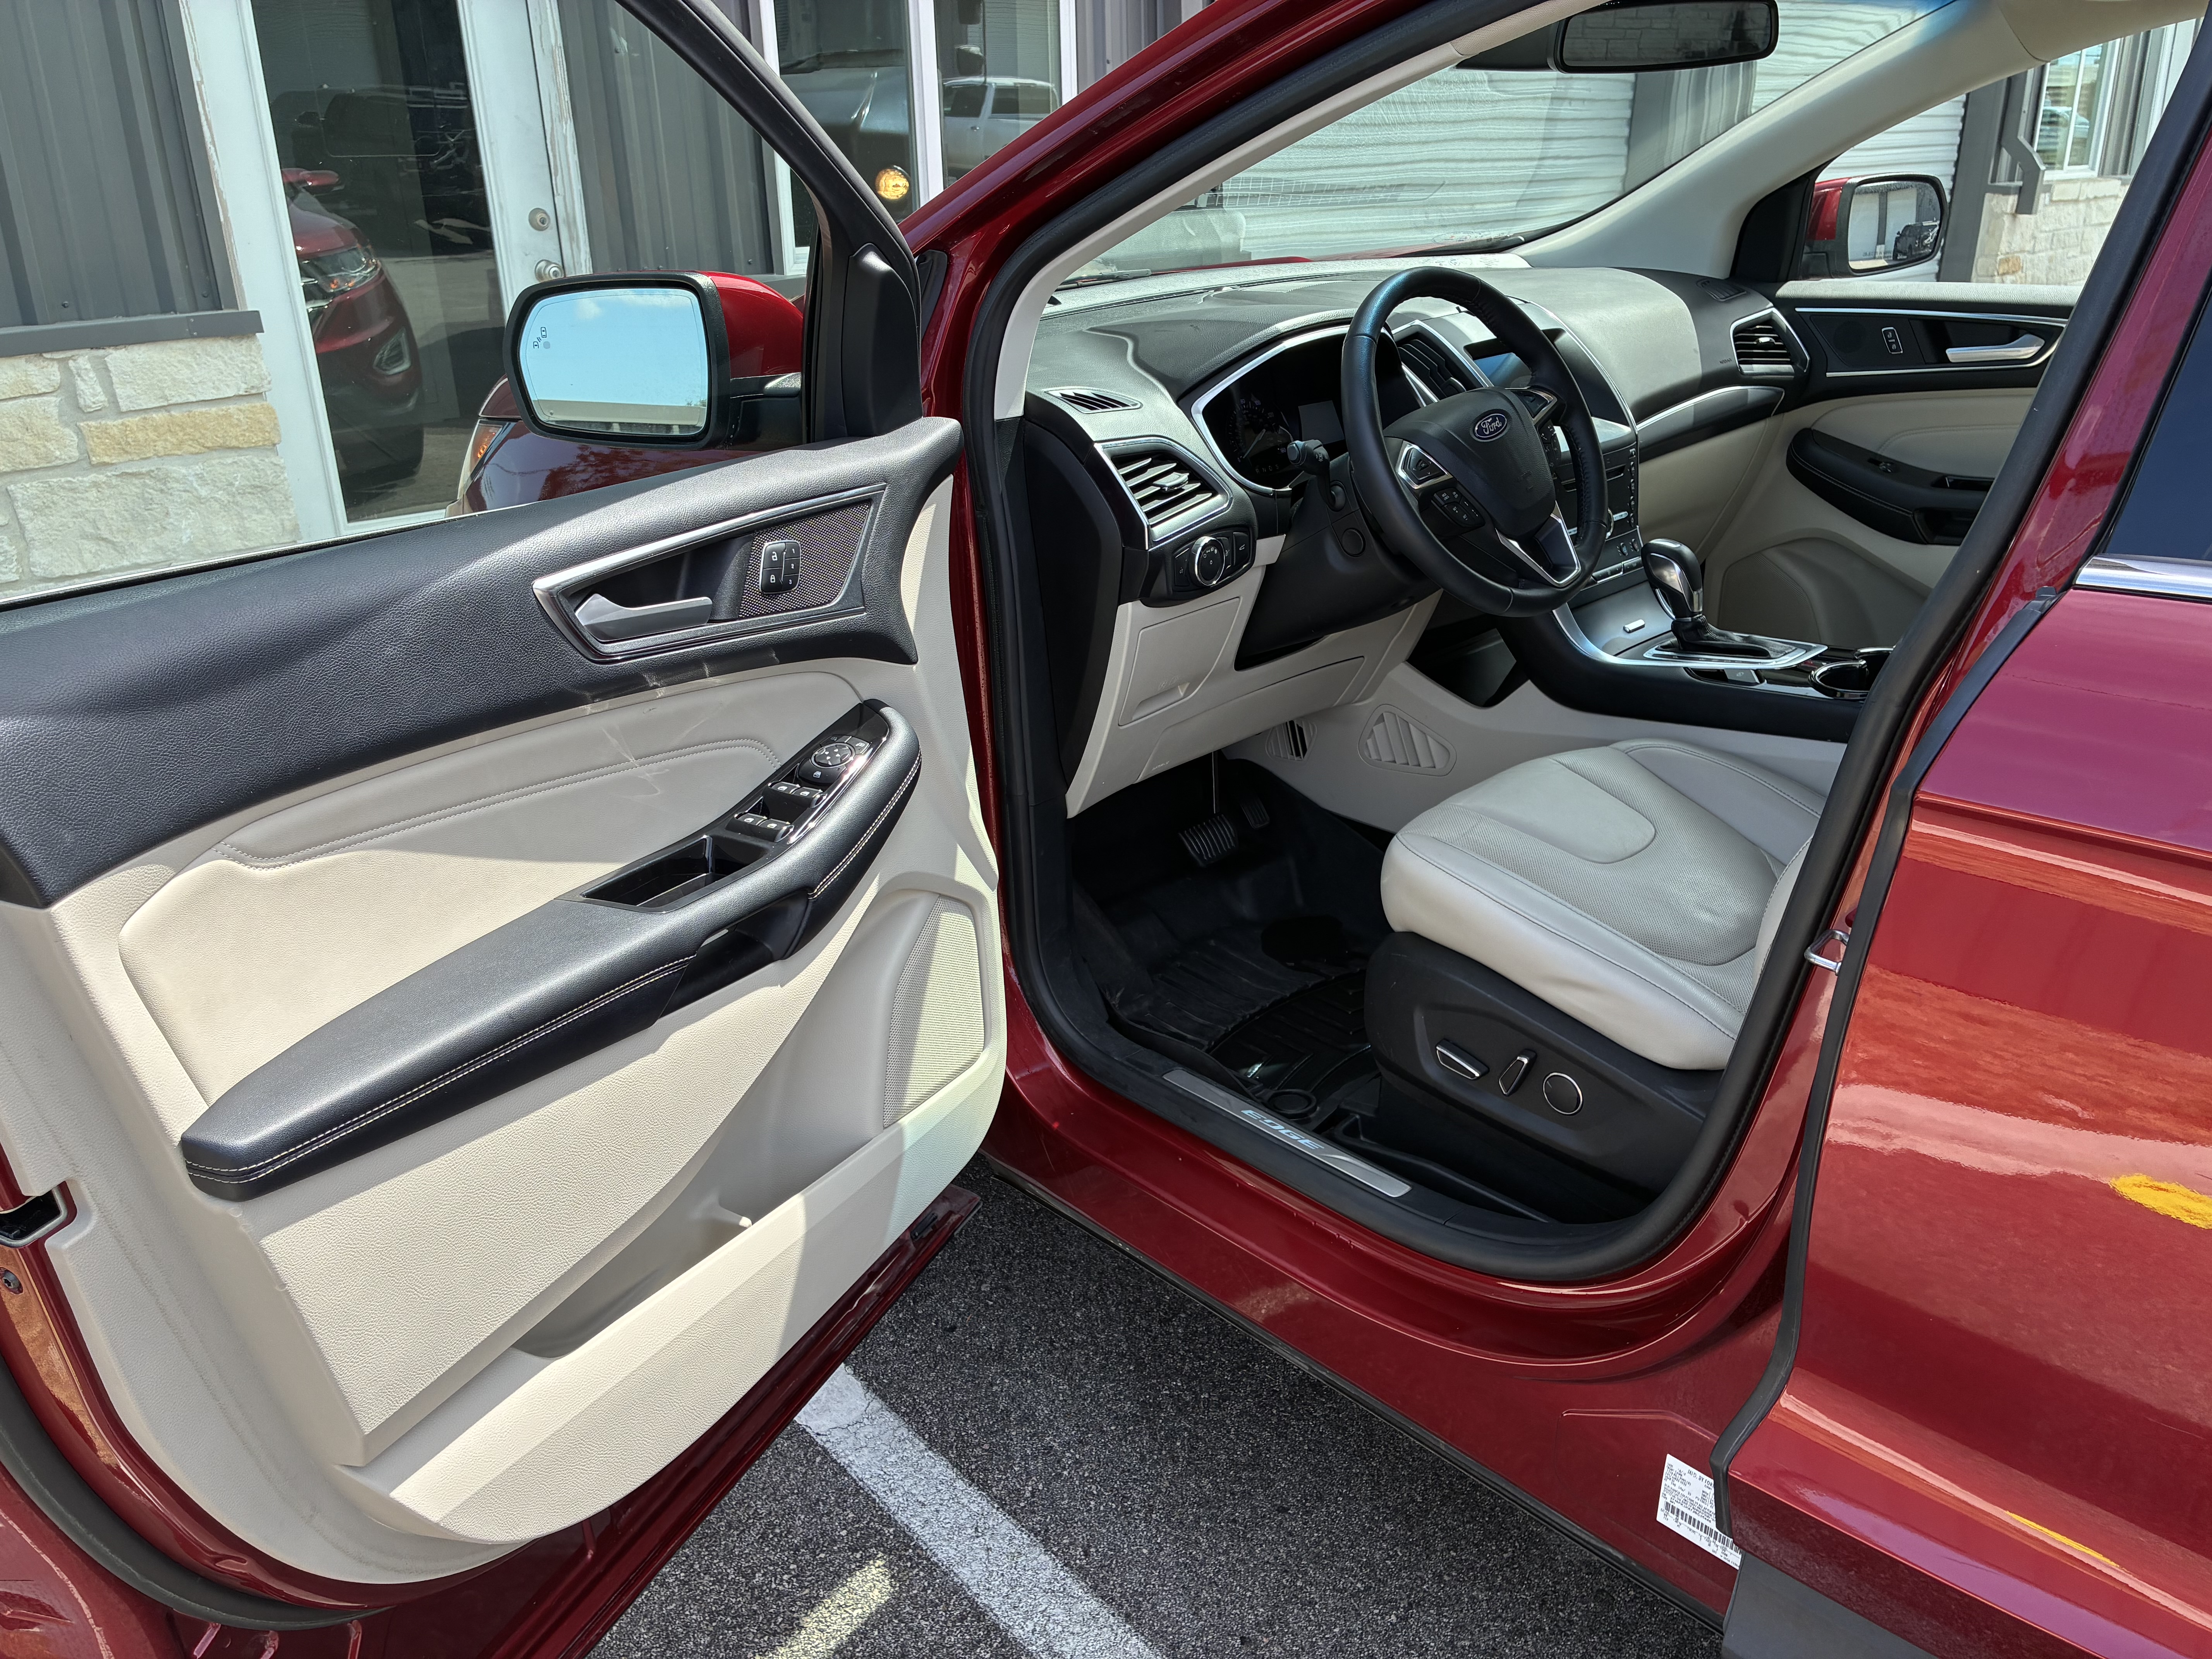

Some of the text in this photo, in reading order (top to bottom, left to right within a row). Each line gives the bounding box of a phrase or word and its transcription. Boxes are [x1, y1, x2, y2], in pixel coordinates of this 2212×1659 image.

[1481, 417, 1502, 434] Ford
[1241, 1110, 1325, 1149] EDGE
[1704, 1479, 1714, 1488] FOR
